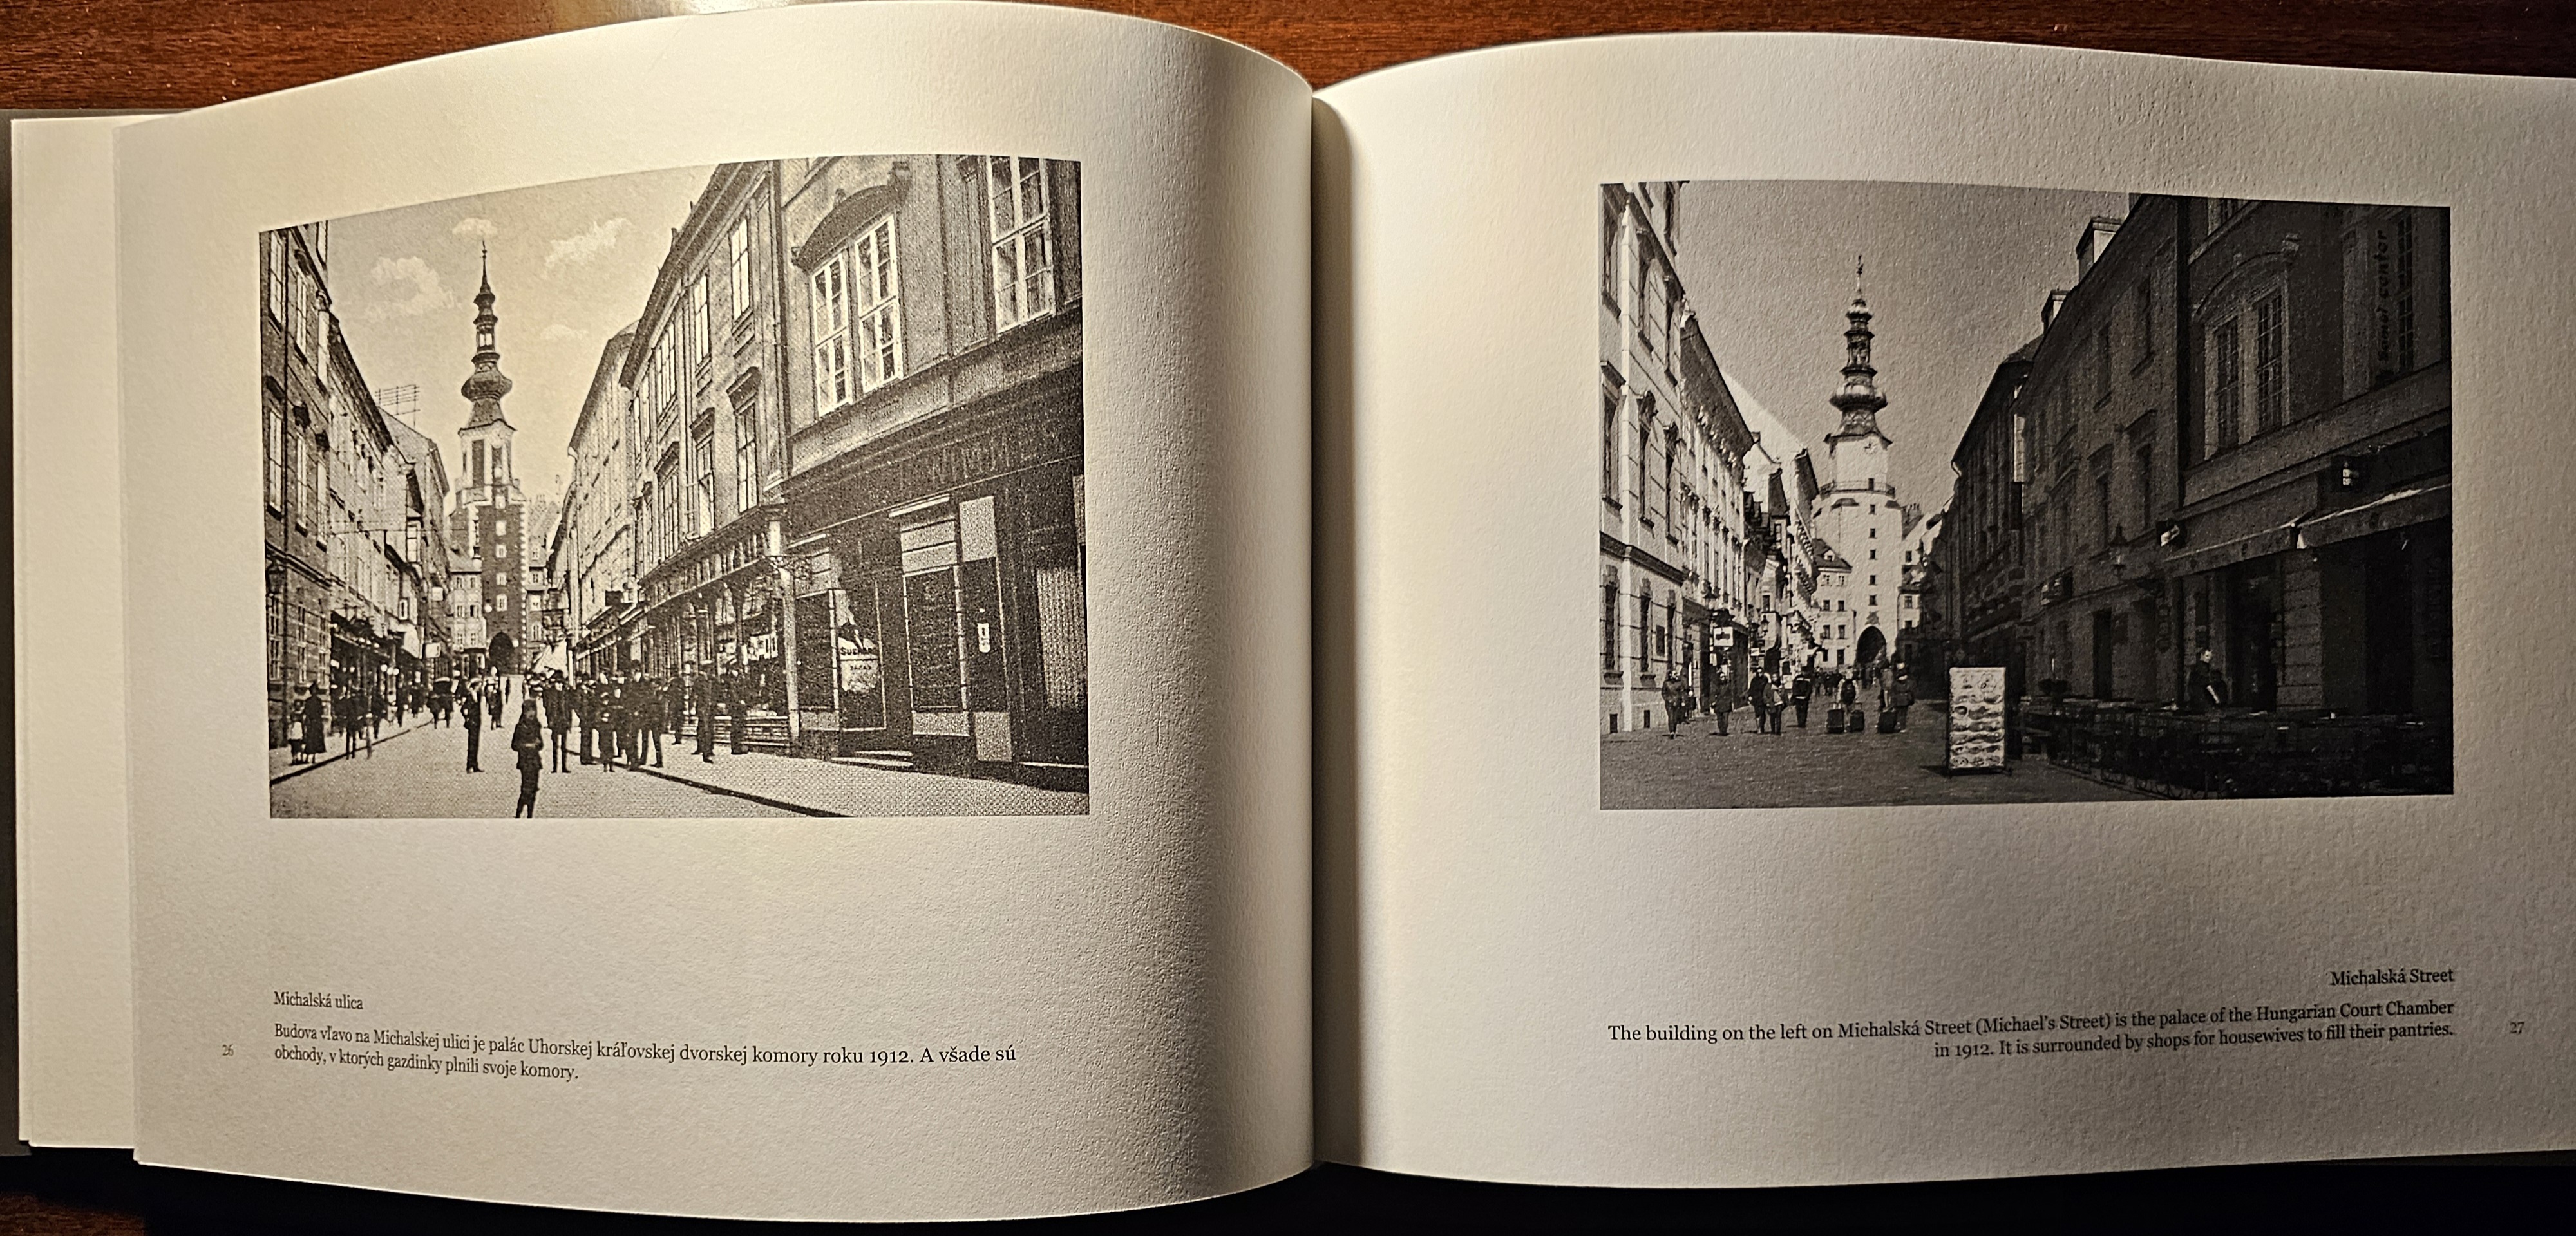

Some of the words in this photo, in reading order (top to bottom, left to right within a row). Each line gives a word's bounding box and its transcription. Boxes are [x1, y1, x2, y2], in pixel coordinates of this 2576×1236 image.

[2330, 968, 2407, 986] Michalská
[2409, 968, 2455, 984] Street
[274, 991, 332, 1008] Michalská
[335, 993, 363, 1010] ulica
[1607, 1024, 1641, 1041] The
[1646, 1024, 1718, 1044] building
[1722, 1029, 1744, 1040] on
[1749, 1024, 1776, 1040] the
[1780, 1023, 1808, 1040] left
[1812, 1027, 1833, 1039] on
[1838, 1020, 1920, 1038] Michalská
[1924, 1020, 1972, 1036] Street
[1976, 1014, 2056, 1036] (Michael's
[2060, 1013, 2112, 1031] Street)
[2115, 1012, 2128, 1028] is
[2131, 1011, 2156, 1027] the
[2159, 1008, 2207, 1030] palace
[2210, 1006, 2226, 1024] of
[2228, 1006, 2253, 1022] the
[2256, 1004, 2336, 1024] Hungarian
[2340, 1002, 2383, 1018] Court
[2385, 999, 2455, 1016] Chamber
[2510, 1021, 2525, 1035] 27
[222, 1044, 234, 1056] 26
[275, 1023, 317, 1040] Budova
[320, 1025, 352, 1042] vľavo
[355, 1032, 370, 1043] na
[374, 1029, 439, 1052] Michalskej
[442, 1033, 469, 1050] ulici
[472, 1035, 485, 1054] je
[489, 1036, 525, 1055] palác
[529, 1038, 592, 1060] Uhorskej
[596, 1040, 675, 1063] kráľovskej
[679, 1044, 747, 1066] dvorskej
[752, 1045, 818, 1067] komory
[823, 1046, 863, 1063] roku
[870, 1051, 914, 1067] 1912.
[919, 1047, 934, 1063] A
[938, 1045, 990, 1062] všade
[996, 1044, 1016, 1061] sú
[1935, 1042, 1950, 1058] in
[1956, 1044, 1994, 1060] 1912.
[1999, 1040, 2012, 1055] It
[2016, 1038, 2029, 1054] is
[2032, 1034, 2122, 1054] surrounded
[2124, 1033, 2144, 1053] by
[2146, 1032, 2191, 1051] shops
[2193, 1030, 2216, 1046] for
[2218, 1027, 2305, 1045] housewives
[2307, 1027, 2323, 1042] to
[2326, 1024, 2346, 1040] fill
[2349, 1023, 2386, 1040] their
[2388, 1021, 2454, 1042] pantries.
[274, 1044, 327, 1065] obchody,
[329, 1053, 337, 1062] v
[339, 1048, 384, 1069] ktorých
[387, 1053, 442, 1074] gazdinky
[446, 1056, 479, 1076] plnili
[482, 1060, 517, 1079] svoje
[520, 1060, 578, 1083] komory.
